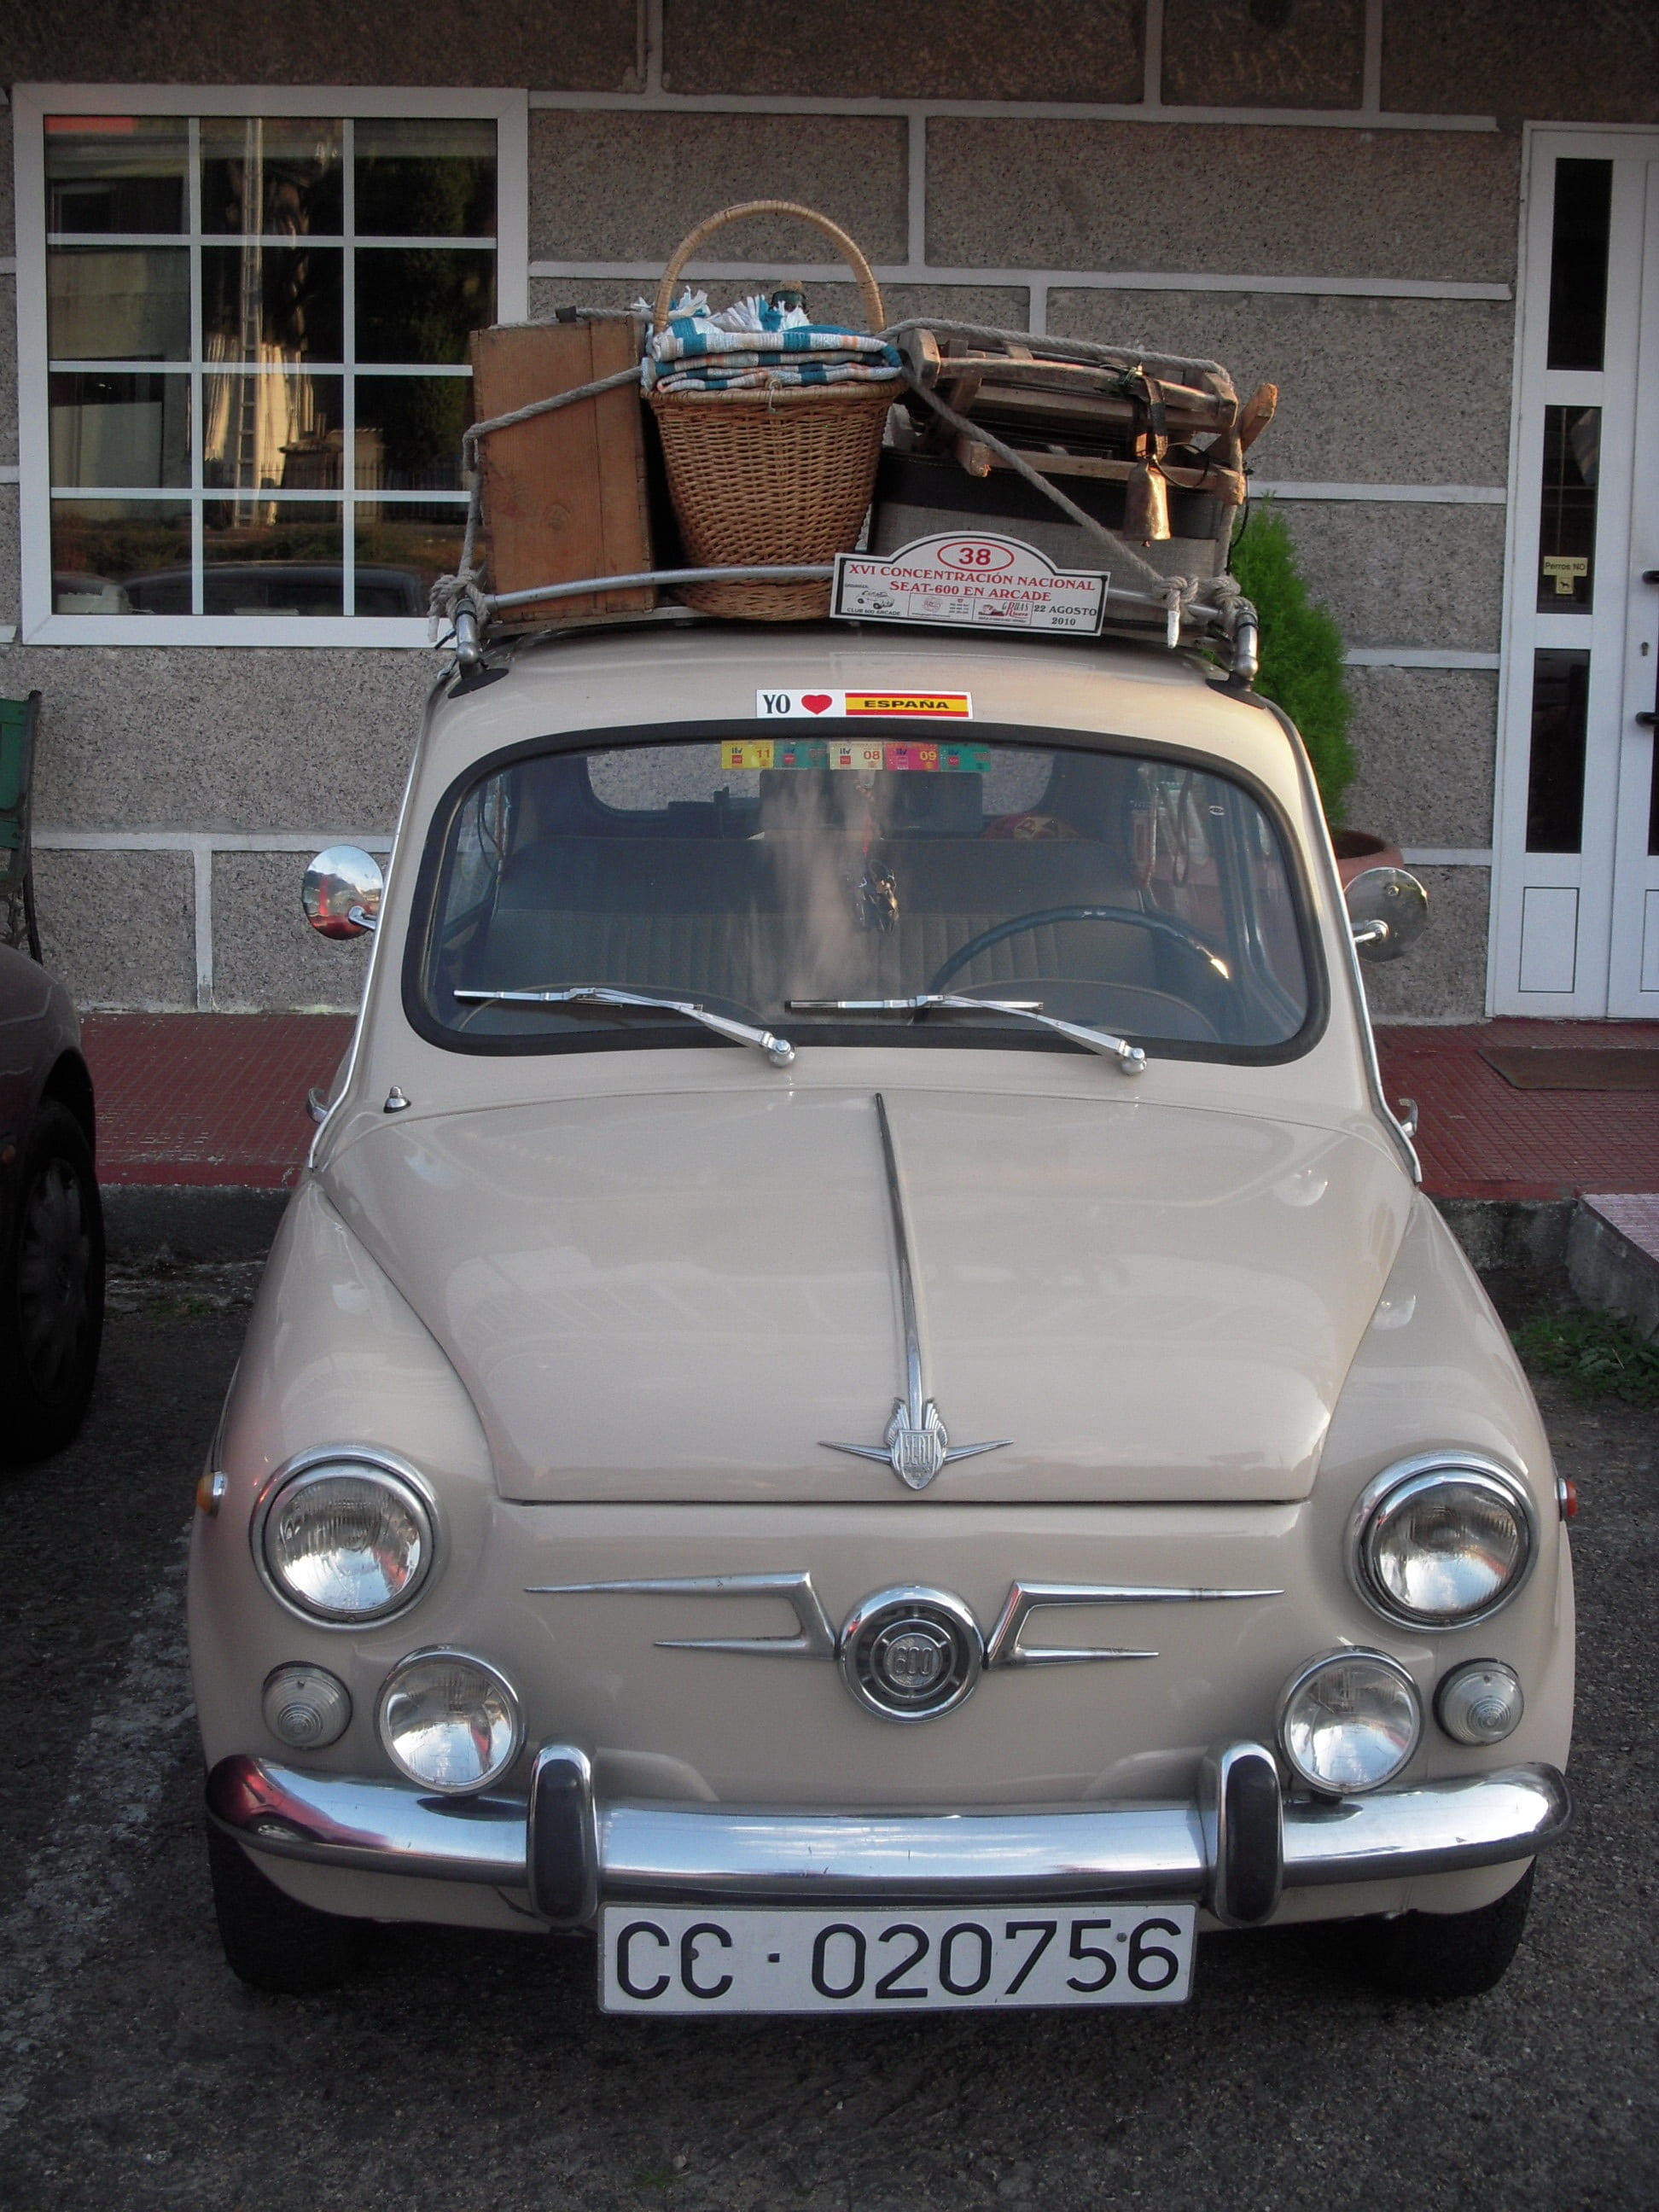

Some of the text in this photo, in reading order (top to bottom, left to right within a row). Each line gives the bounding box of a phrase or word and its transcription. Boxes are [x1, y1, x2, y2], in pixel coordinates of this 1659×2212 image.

[958, 547, 992, 565] 38
[848, 564, 1096, 591] XVI CONCENTRACIÓN NACIONAL
[889, 580, 1051, 602] SEAT-600 EN ARCADE
[1033, 604, 1097, 616] 22 AGOSTO
[1051, 617, 1076, 626] 2010
[762, 694, 791, 714] YO
[864, 699, 950, 710] ESPAÑA
[756, 749, 771, 758] 11
[863, 750, 881, 760] 08
[919, 750, 937, 760] 09
[904, 1434, 934, 1465] SEAT
[894, 1645, 933, 1675] 600
